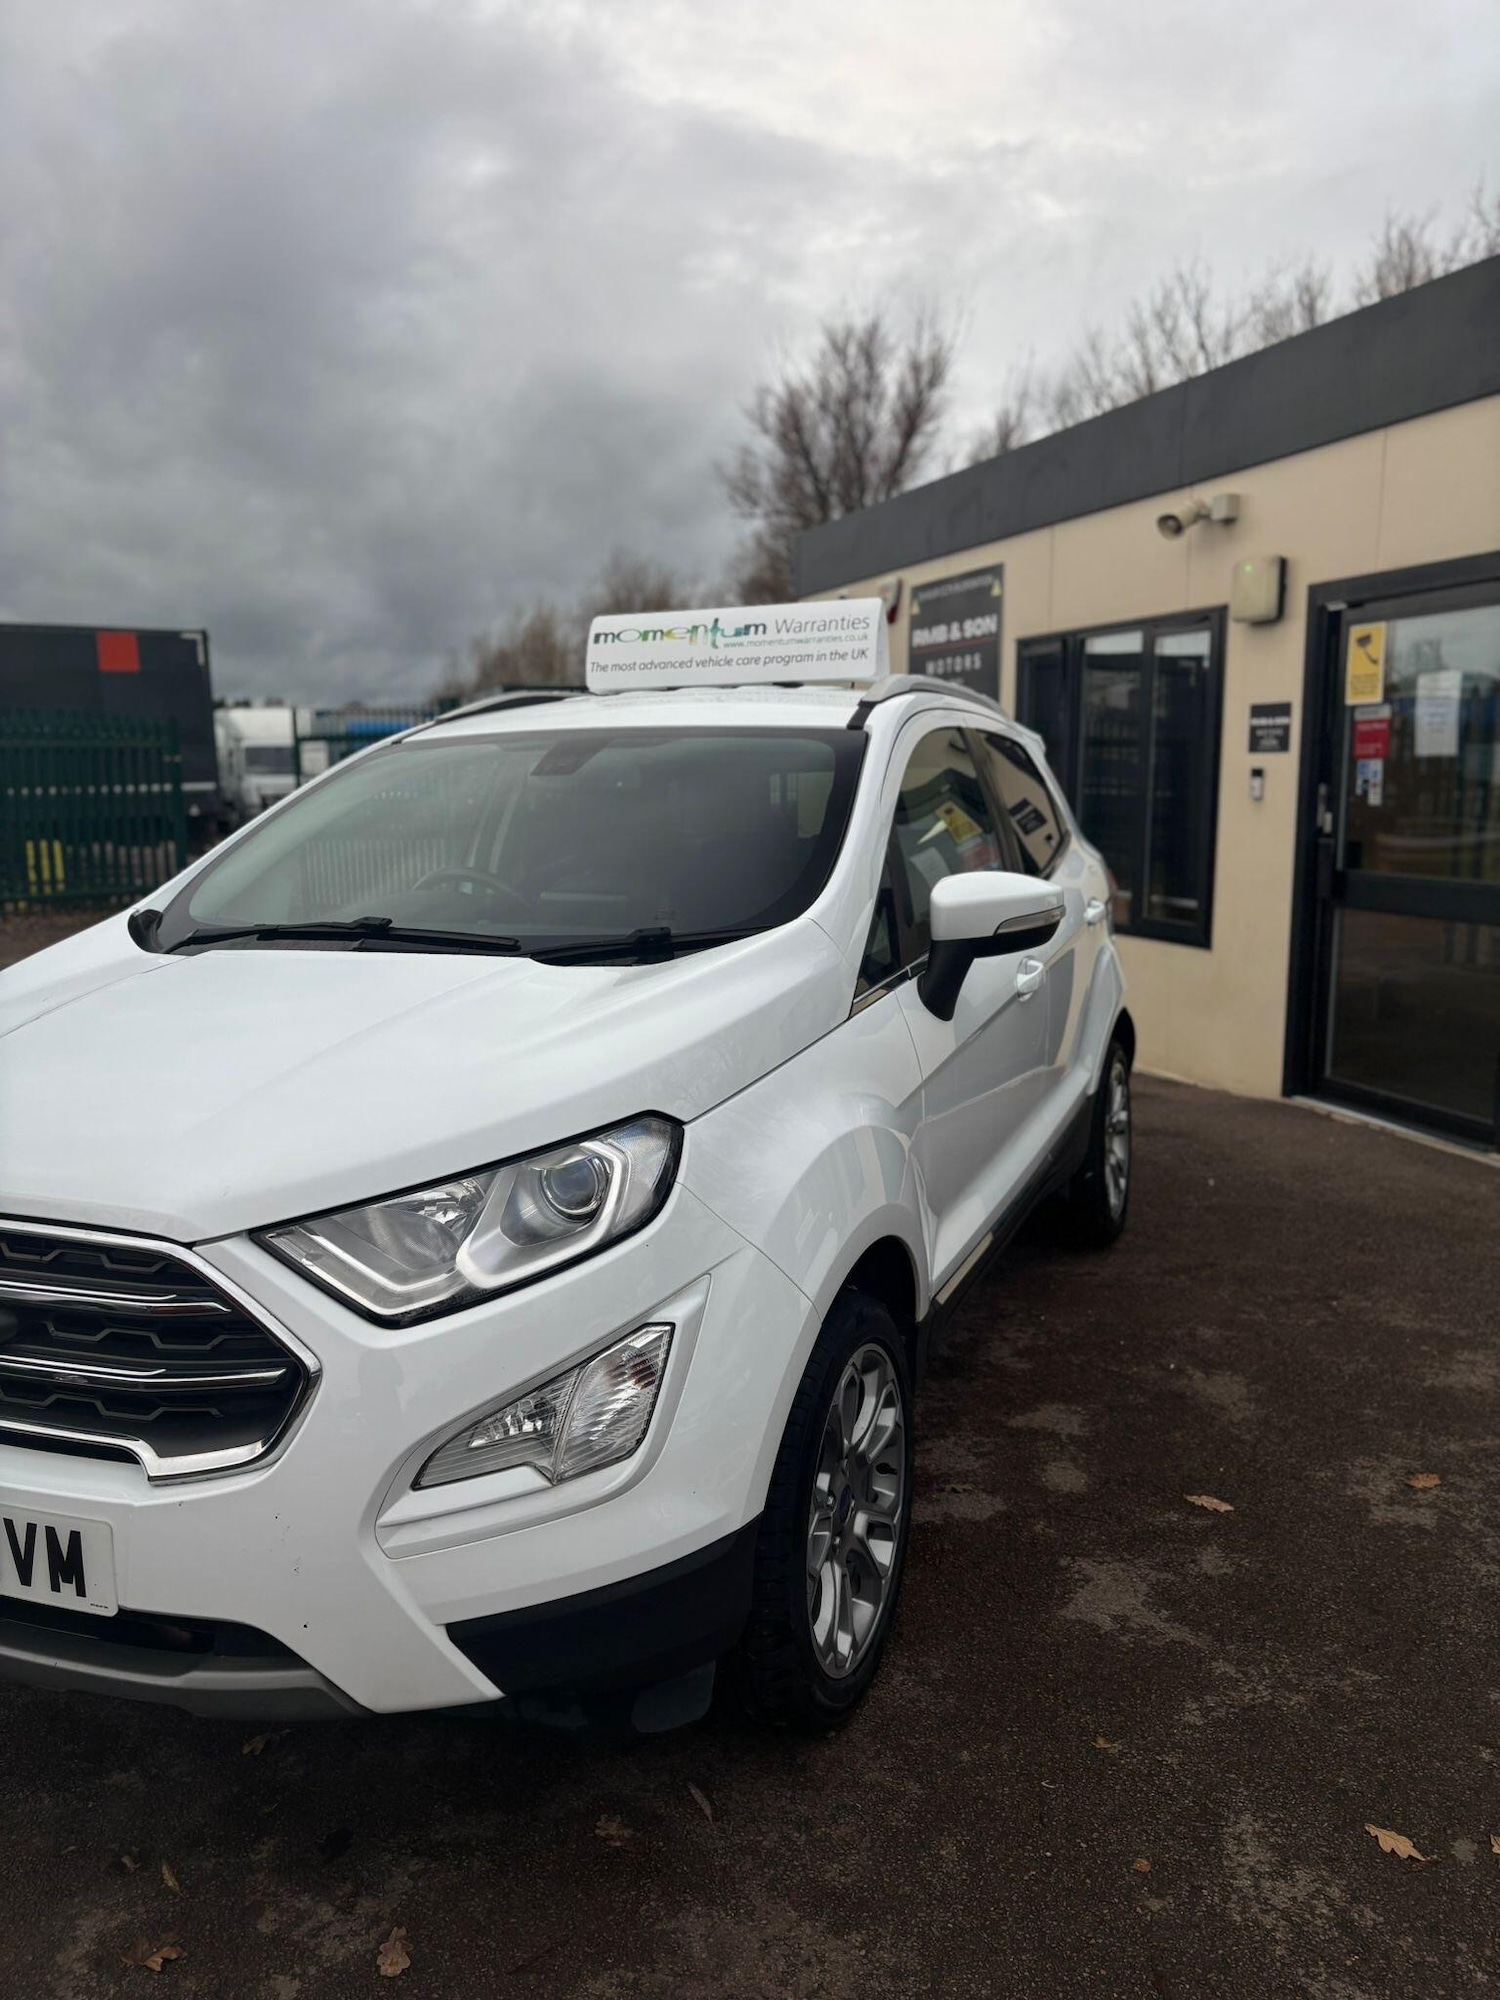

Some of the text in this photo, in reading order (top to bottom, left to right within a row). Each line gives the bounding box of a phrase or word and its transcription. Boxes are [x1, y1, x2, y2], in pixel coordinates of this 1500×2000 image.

[594, 615, 870, 649] momentum Warranties
[963, 613, 998, 638] SON
[723, 634, 868, 648] www.momentumwarranties.co.uk
[590, 648, 868, 673] The most advanced vehicle care program in the UK
[3, 1517, 87, 1598] VM
